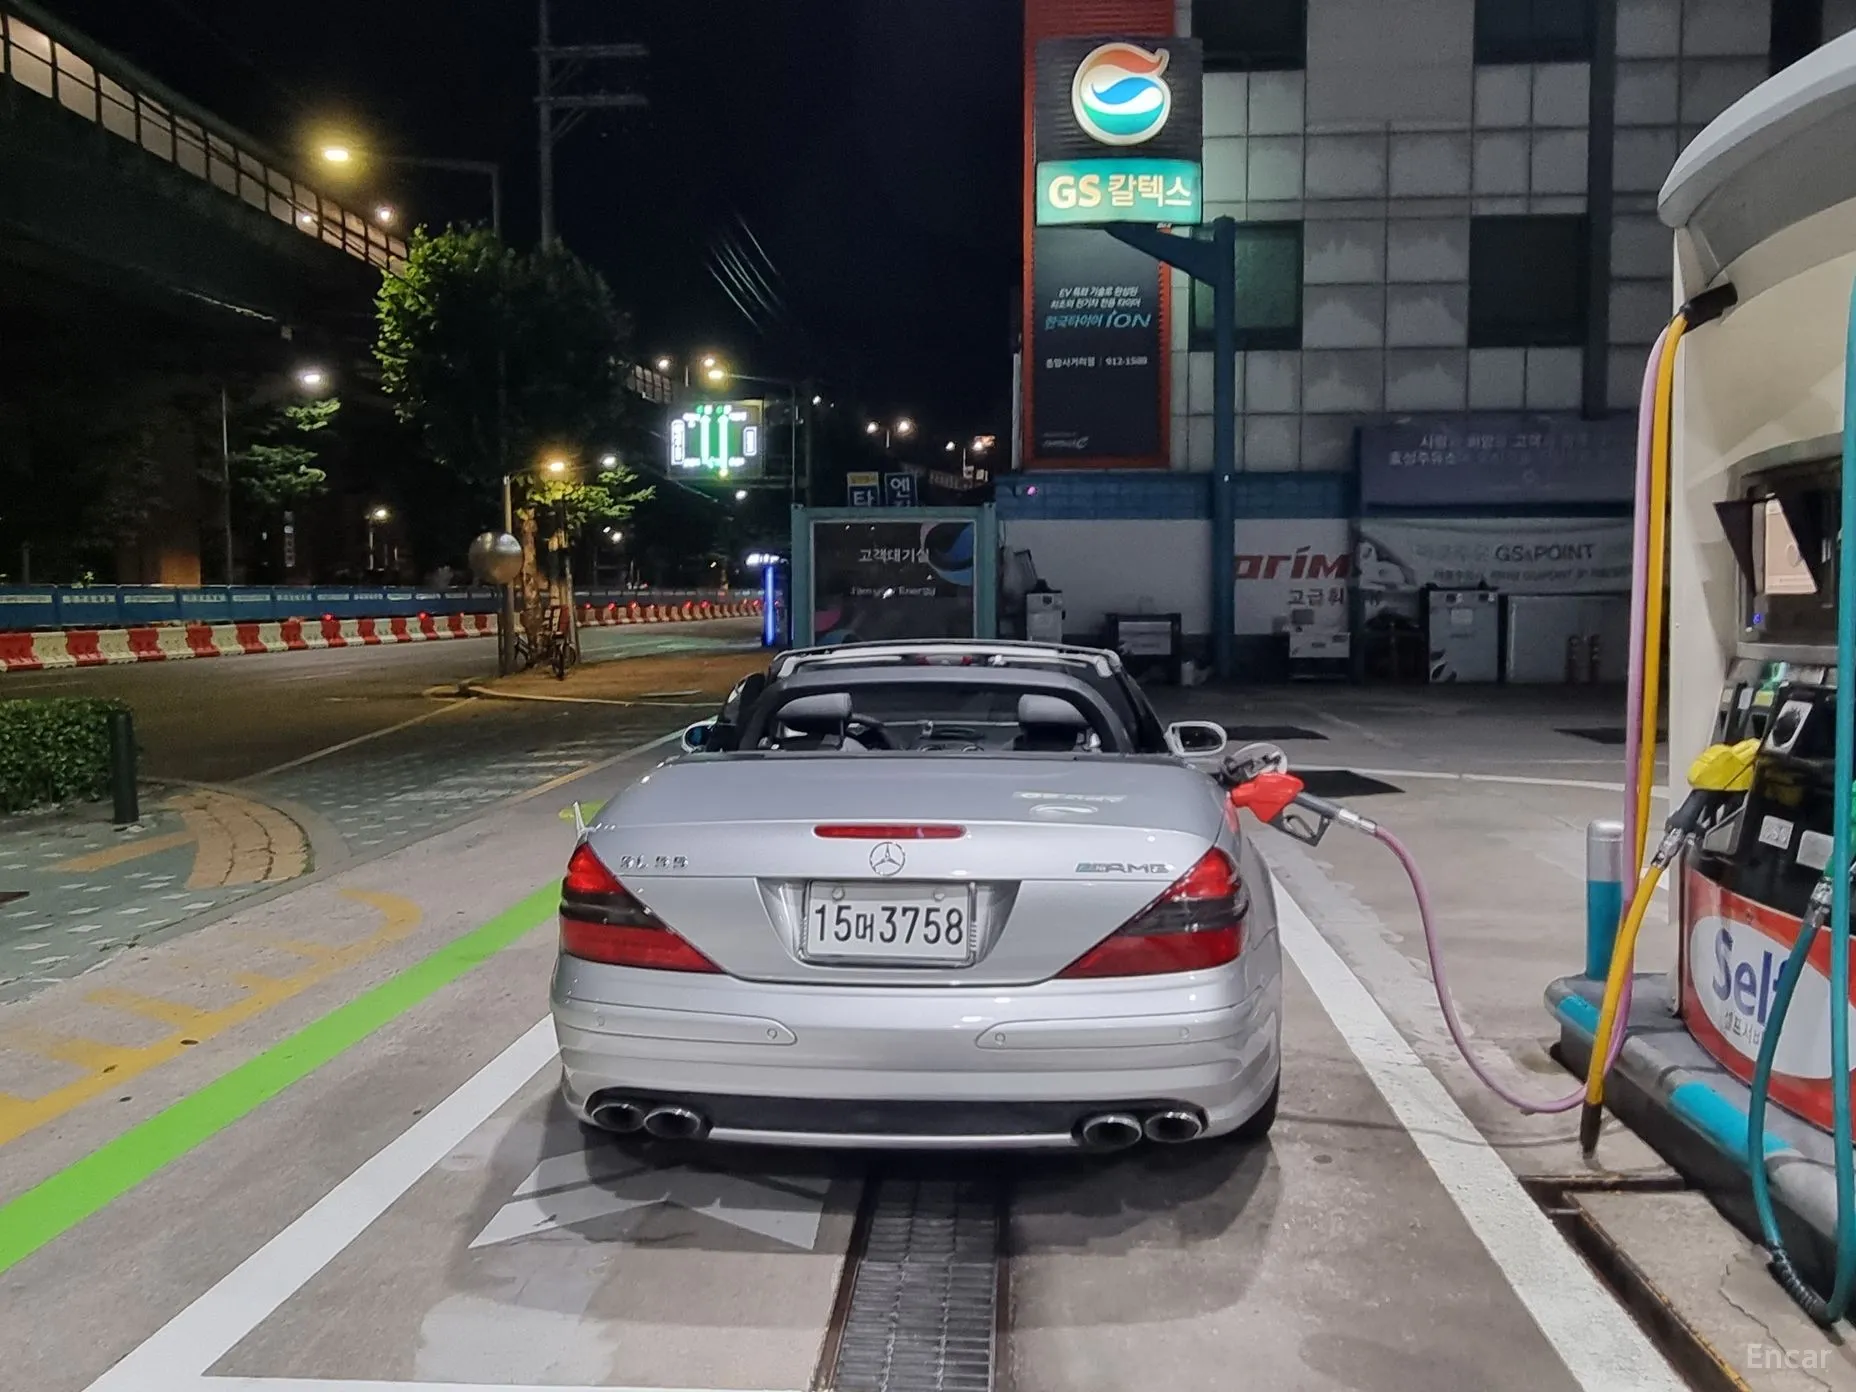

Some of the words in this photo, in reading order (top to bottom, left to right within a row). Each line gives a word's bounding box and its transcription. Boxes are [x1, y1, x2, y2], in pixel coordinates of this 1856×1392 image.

[1048, 174, 1102, 209] GS
[1108, 174, 1193, 208] 칼텍스
[1045, 312, 1103, 331] 한국타이어
[858, 547, 930, 564] 고객대기실
[814, 903, 964, 946] 15머3758
